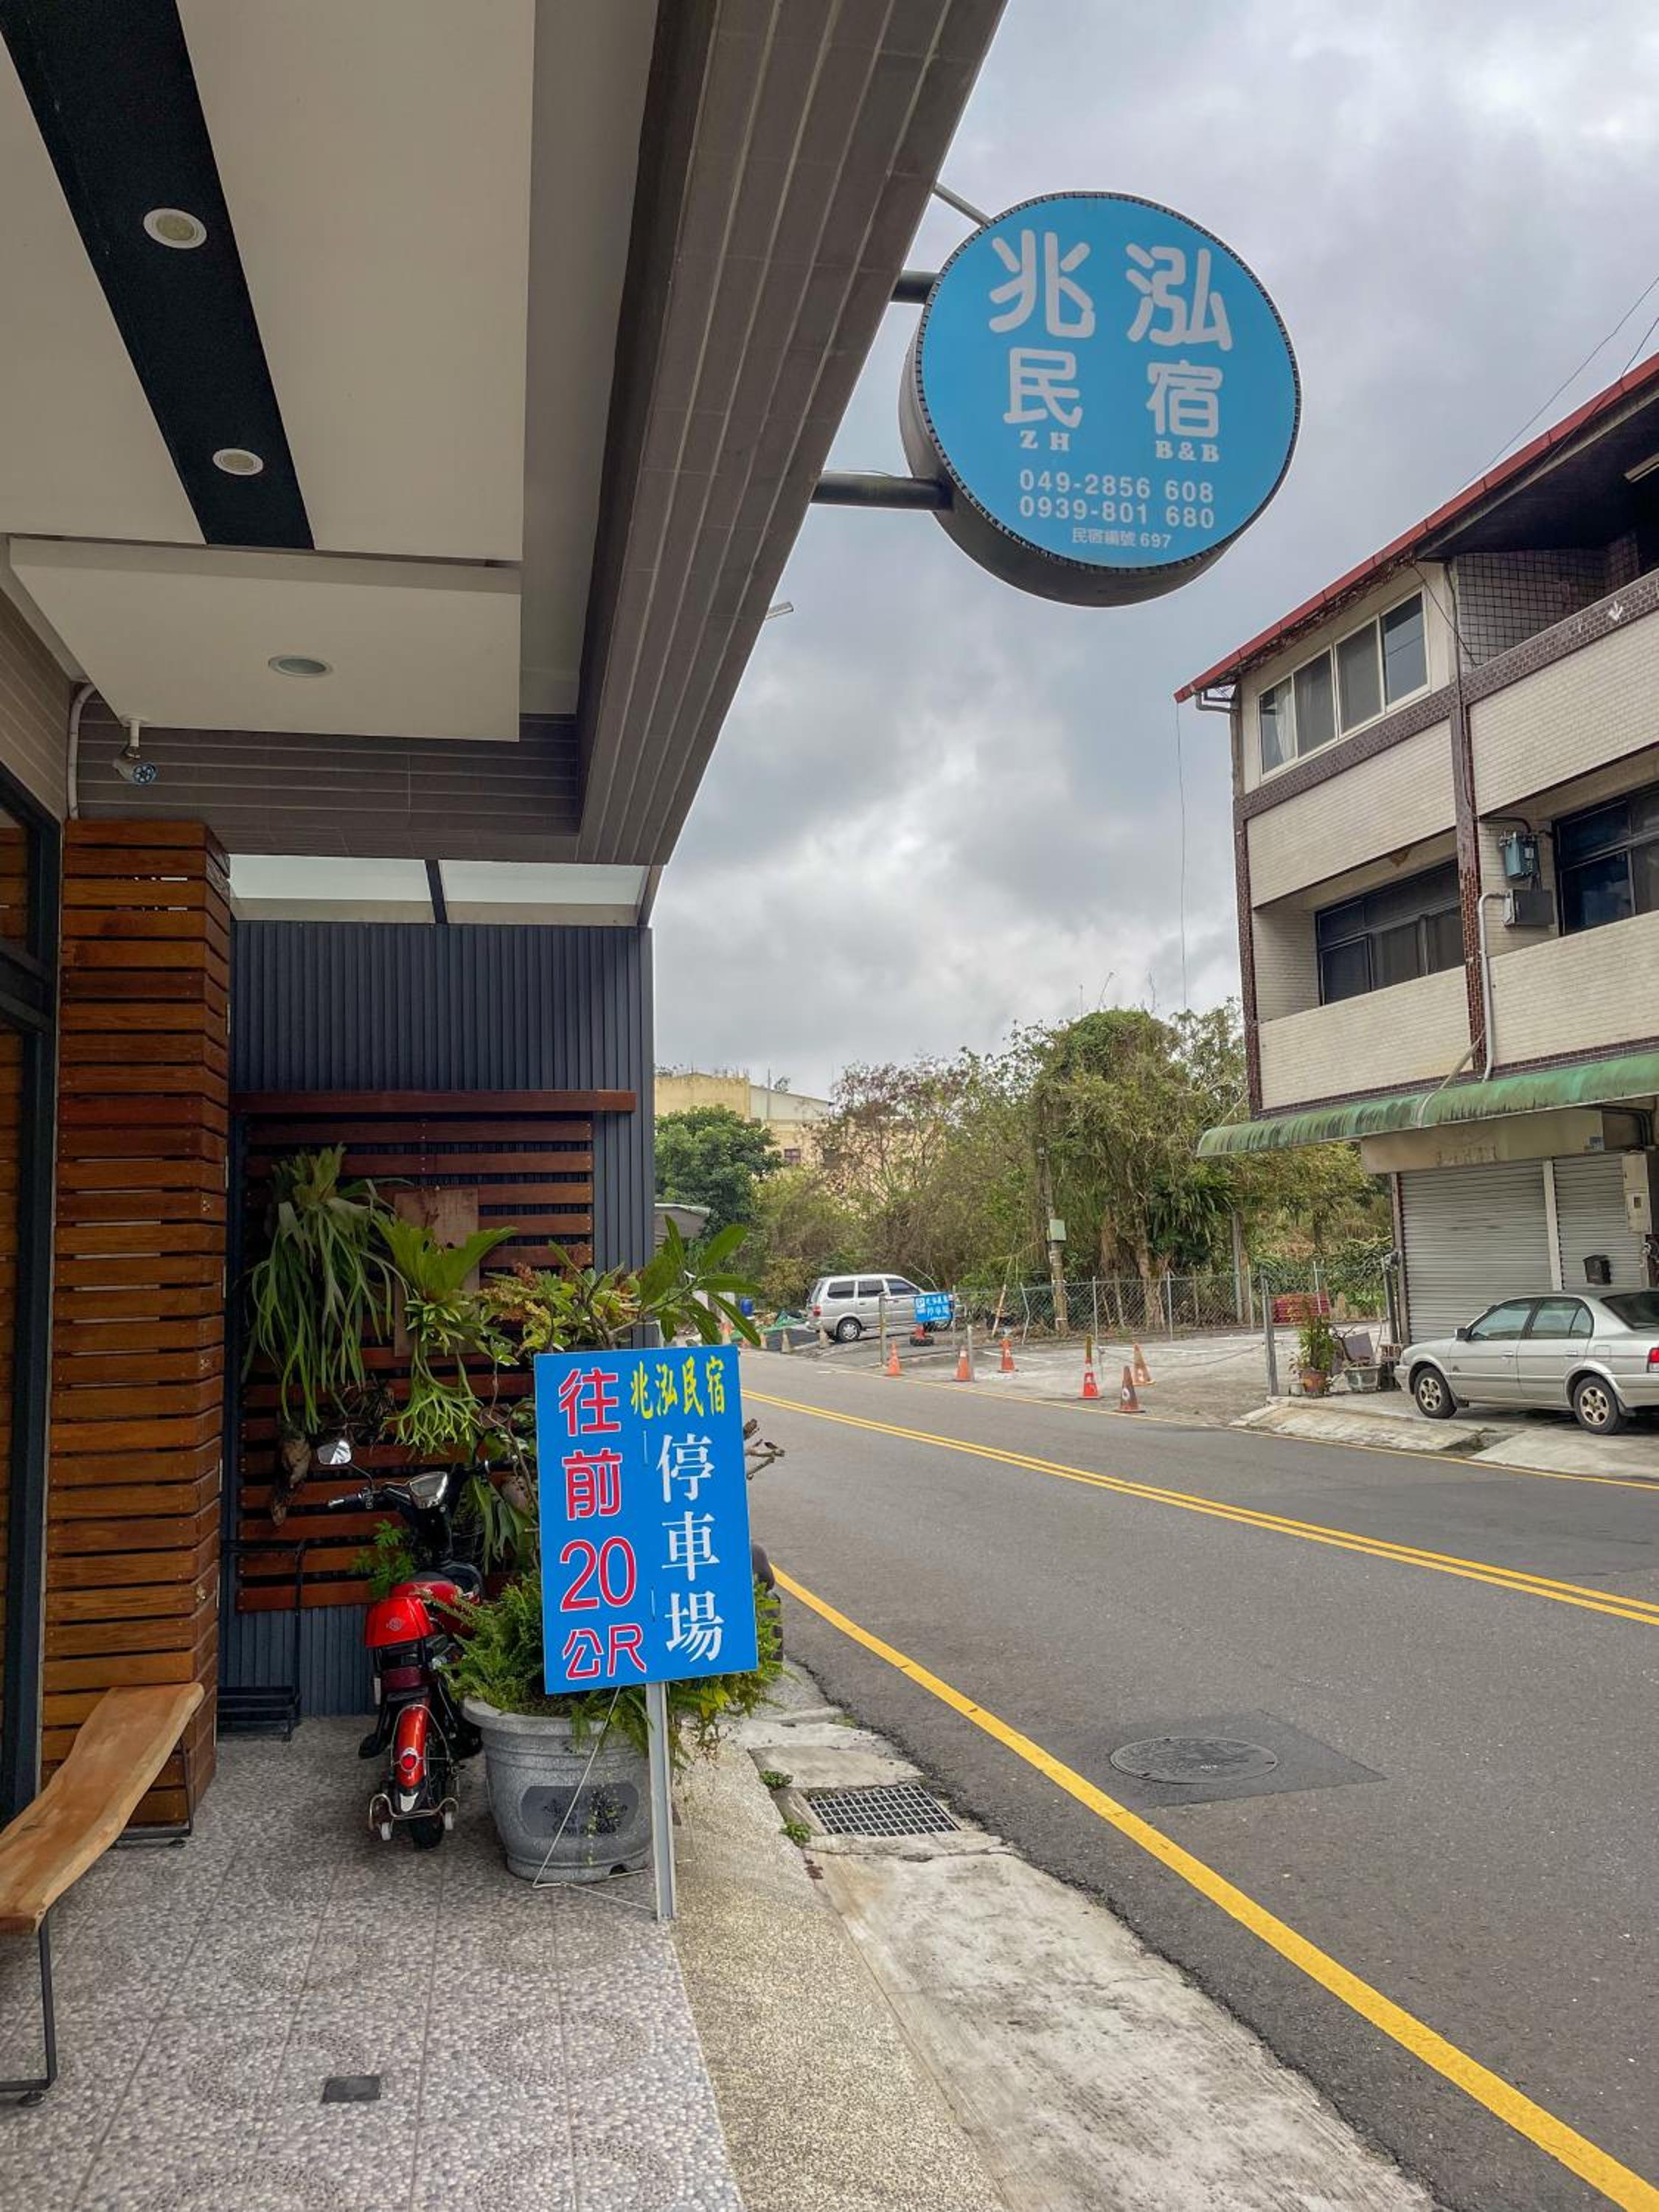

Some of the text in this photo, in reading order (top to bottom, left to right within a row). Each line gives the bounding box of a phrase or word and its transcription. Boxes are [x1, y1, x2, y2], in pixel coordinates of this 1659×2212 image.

[1020, 469, 1214, 503] 049-2856 608
[1020, 495, 1214, 529] 0939-801 680
[1140, 532, 1171, 549] 697
[630, 1355, 726, 1420] 兆泓民宿
[657, 1433, 725, 1663] 停車場
